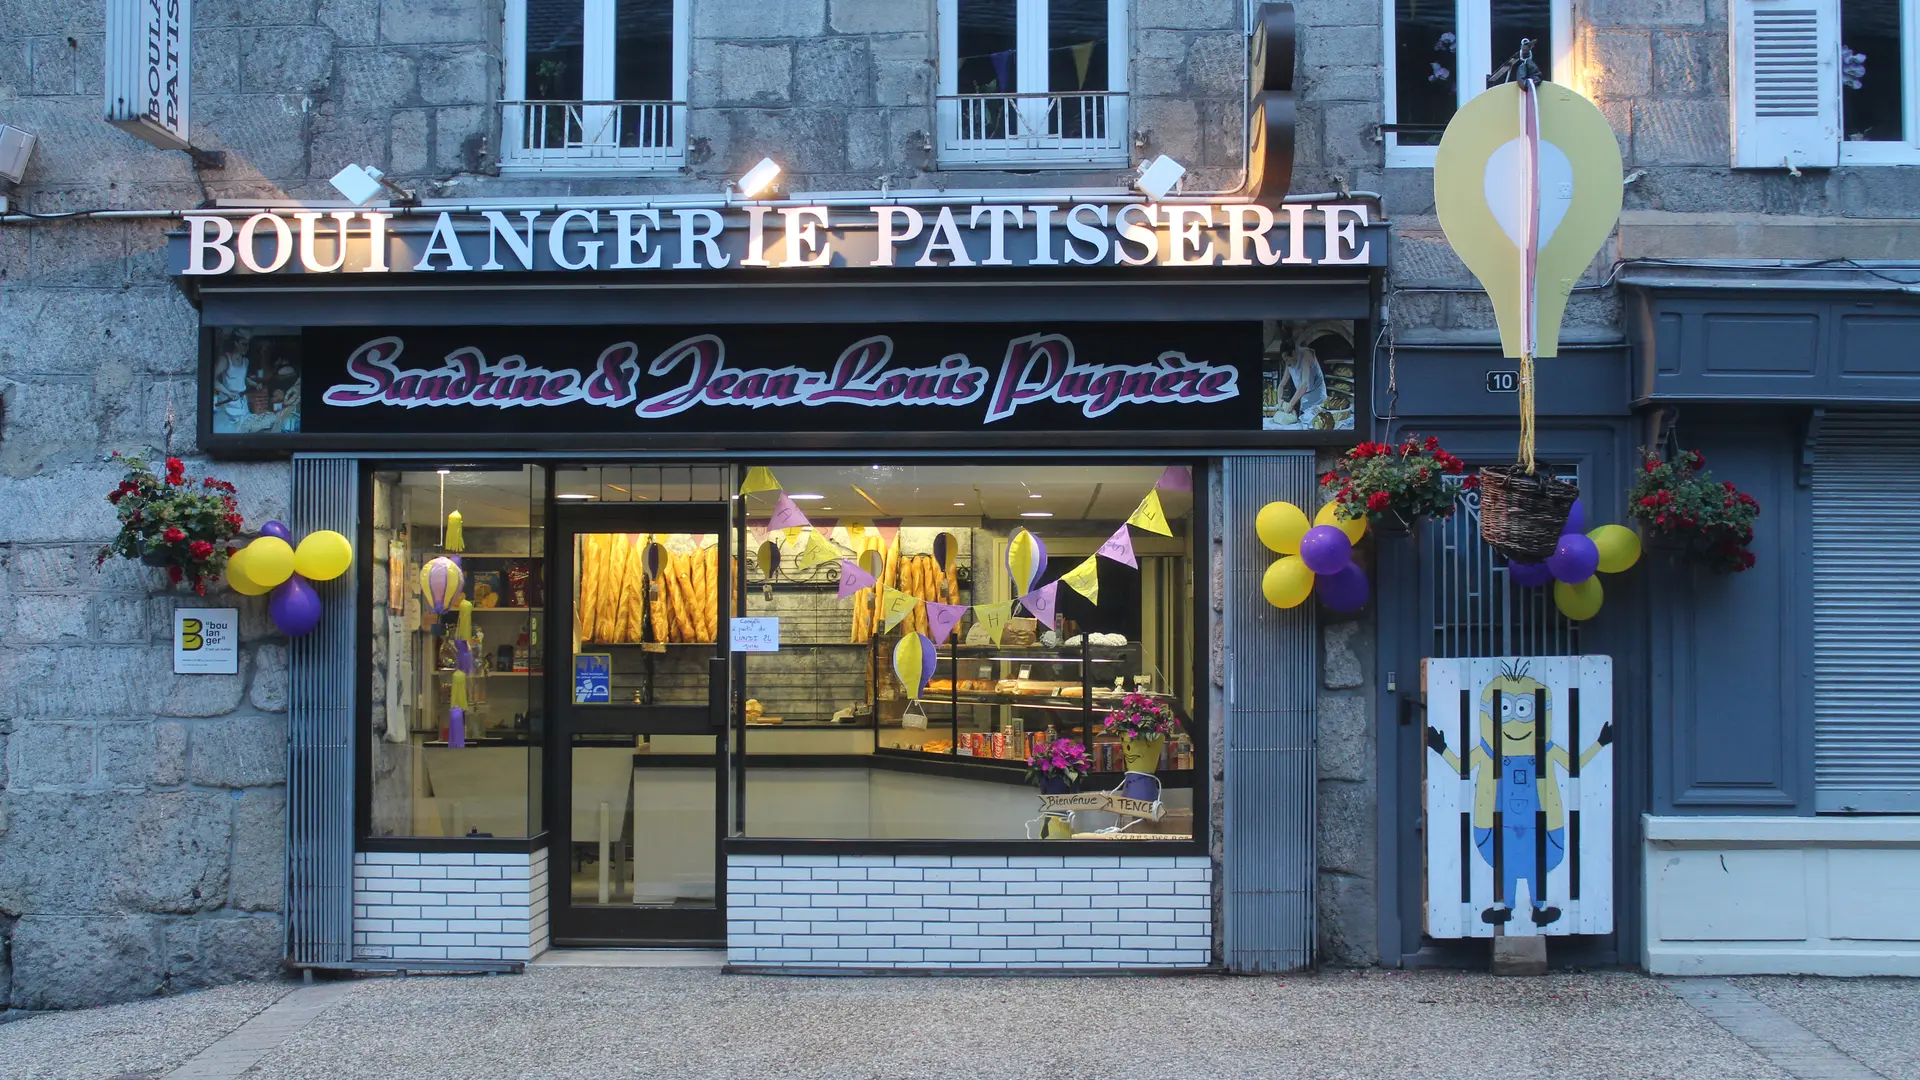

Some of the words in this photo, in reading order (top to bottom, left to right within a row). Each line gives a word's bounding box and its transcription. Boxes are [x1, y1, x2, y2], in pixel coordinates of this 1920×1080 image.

[869, 203, 1371, 267] PATISSERIE
[322, 336, 584, 409] Sandrine
[582, 341, 639, 408] &
[635, 333, 990, 418] Jean-Louis
[983, 331, 1240, 424] Pugnère
[1493, 374, 1512, 389] 10
[206, 629, 220, 637] lan
[1046, 795, 1098, 810] Bienvenue
[1116, 799, 1154, 814] TENCE
